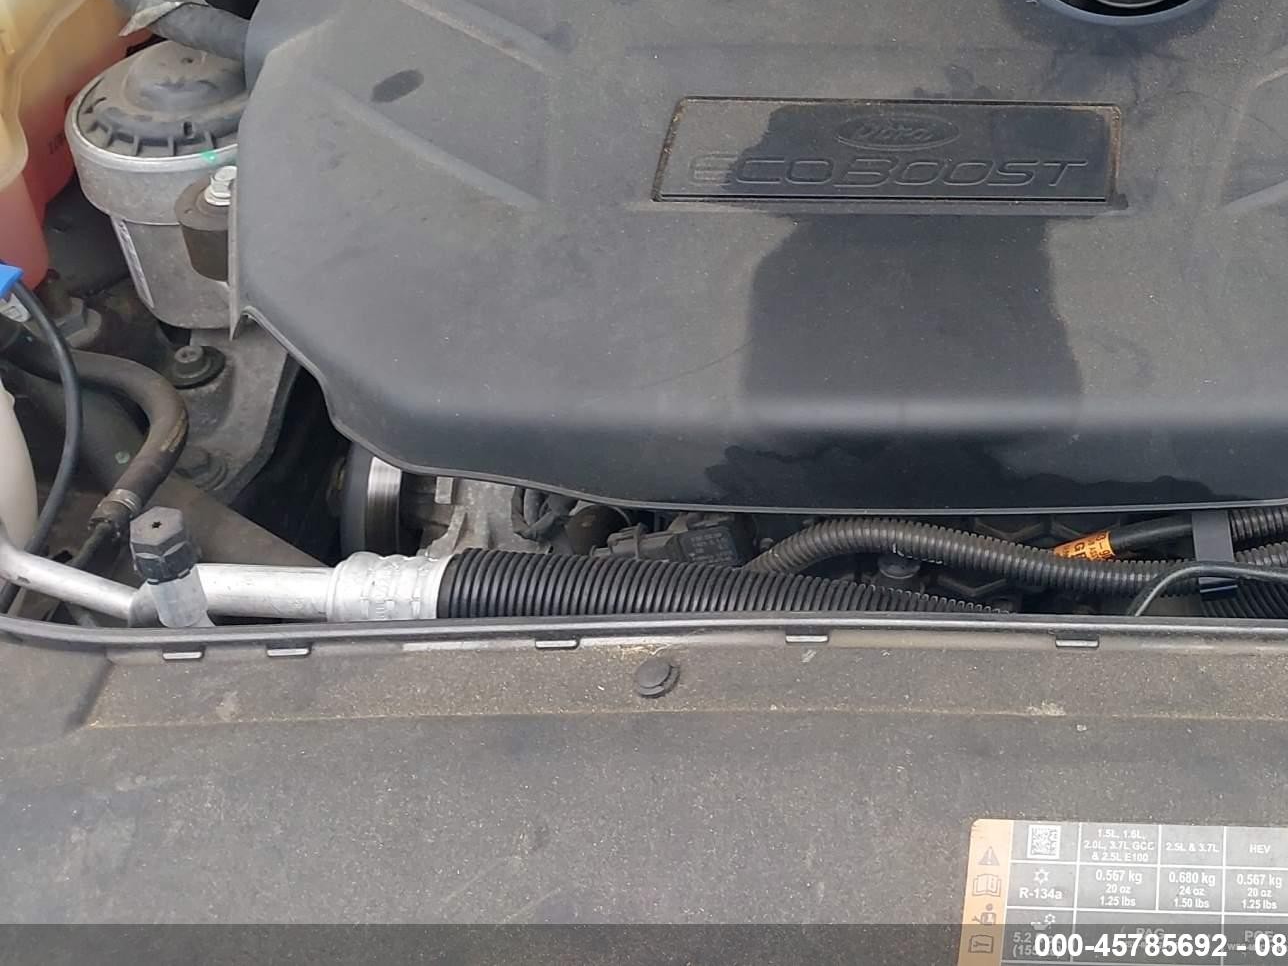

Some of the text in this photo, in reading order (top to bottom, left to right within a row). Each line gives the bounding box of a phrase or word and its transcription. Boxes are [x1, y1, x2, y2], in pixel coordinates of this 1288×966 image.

[1110, 841, 1131, 851] 3.7L
[1165, 842, 1187, 852] 2.5L
[1199, 843, 1220, 853] 3.7L
[1249, 844, 1271, 854] HEV
[1101, 852, 1123, 862] 2.5L
[1125, 853, 1149, 863] E100
[1095, 869, 1143, 885] 0.567 kg
[1168, 871, 1216, 887] 0.680 kg
[1236, 873, 1283, 889] 0.567 kg
[1019, 887, 1063, 900] R-134a
[1105, 884, 1132, 894] 20 oz
[1178, 886, 1205, 896] 24 oz
[1247, 887, 1272, 898] 20 oz
[1099, 896, 1136, 907] 1.25 lbs
[1173, 898, 1210, 909] 1.50 lbs
[1241, 899, 1278, 910] 1.25 lbs
[1012, 931, 1032, 943] 5.2
